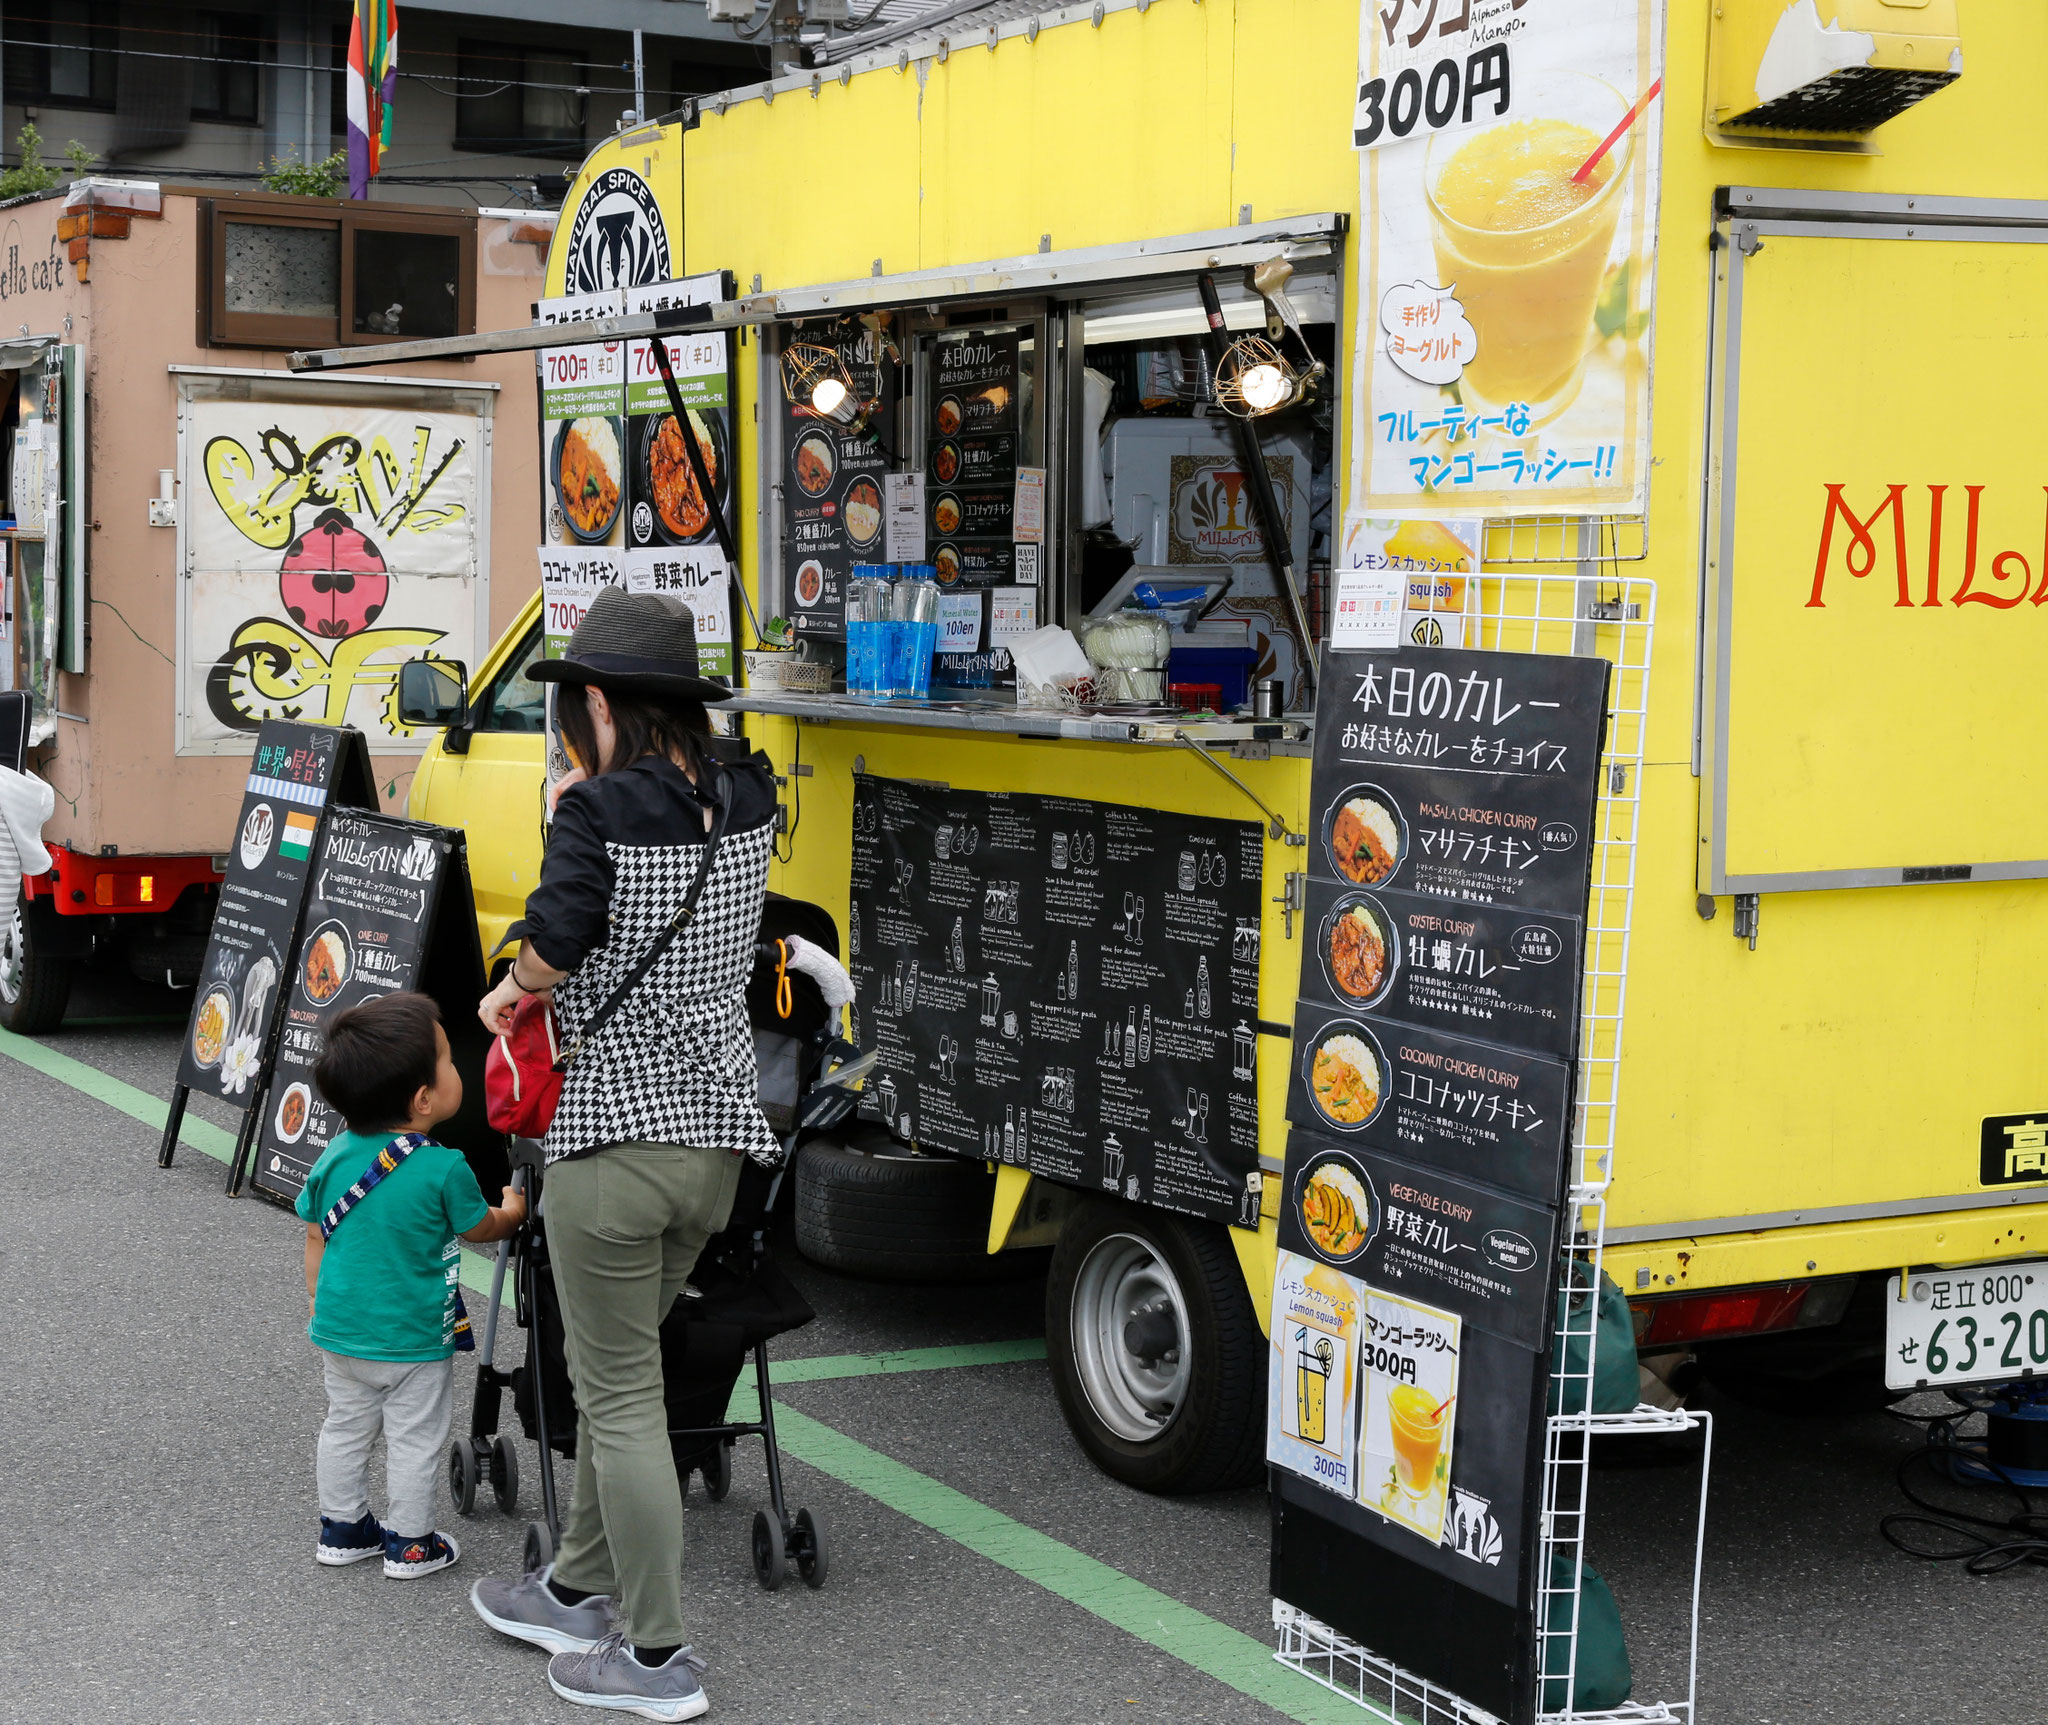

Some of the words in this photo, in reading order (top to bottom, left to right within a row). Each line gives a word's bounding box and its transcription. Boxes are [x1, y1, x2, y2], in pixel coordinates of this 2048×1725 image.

[1470, 2, 1511, 25] Alphonso
[1354, 42, 1510, 146] 300円
[566, 182, 606, 294] NATURAL
[608, 172, 649, 206] SPICE
[648, 207, 670, 280] ONLY
[32, 234, 64, 290] cafe
[1402, 299, 1441, 327] 手作り
[942, 344, 1007, 368] 本日のカレー
[1393, 332, 1462, 362] ヨーグルト
[548, 354, 587, 382] 700円
[940, 364, 1011, 383] お好きなカレーをチョイス
[1378, 401, 1530, 442] フルーティーな
[1409, 446, 1616, 487] マンゴーラッシー!!
[965, 503, 1012, 516] ココナッツチキン
[795, 522, 842, 540] 2種盛カレー
[1197, 531, 1264, 546] MILLAN
[543, 560, 619, 585] ココナッツチキン
[653, 562, 722, 590] 野菜カレー
[824, 567, 842, 580] カレー
[964, 556, 993, 568] 野菜カレー
[1353, 553, 1452, 573] レモンスカッシュ
[547, 587, 564, 596] Coconut
[564, 589, 579, 597] Chicken
[580, 590, 592, 598] Curry
[683, 591, 697, 602] Curry
[1409, 582, 1452, 599] squash
[941, 654, 988, 672] MILLAN
[1352, 664, 1560, 725] 本日のカレー
[1341, 723, 1568, 773] お好きなカレーをチョイス
[257, 745, 326, 783] 世界の屋台から
[331, 816, 380, 838] 南インドカレー
[1420, 802, 1457, 821] MASALA
[1459, 807, 1502, 826] CHICKEN
[1504, 812, 1537, 831] CURRY
[324, 835, 401, 873] MILLAN
[1419, 828, 1540, 870] マサラチキン
[357, 930, 373, 942] ONE
[1409, 915, 1442, 931] OYSTER
[1444, 919, 1475, 937] CURRY
[1524, 931, 1548, 943] 広島産
[1408, 934, 1521, 979] 牡蠣カレー
[1520, 944, 1552, 956] 大粒牡蠣
[1400, 1046, 1443, 1070] COCONUT
[1444, 1057, 1485, 1081] CHICKEN
[1487, 1068, 1519, 1089] CURRY
[311, 1100, 336, 1116] カレー
[1228, 1092, 1247, 1104] Coffee
[1399, 1070, 1543, 1132] ココナッツチキン
[308, 1117, 327, 1135] 単品
[307, 1135, 328, 1148] 500yen
[1179, 1146, 1197, 1156] dinner
[2003, 1120, 2048, 1178] 高
[1389, 1182, 1440, 1212] VEGETABLE
[1441, 1200, 1473, 1222] CURRY
[1387, 1205, 1477, 1254] 野菜カレー
[1490, 1235, 1530, 1256] Vegetarians
[1500, 1252, 1518, 1264] menu
[1281, 1277, 1348, 1312] レモンスカッシュ
[1930, 1279, 1976, 1310] 足立
[1982, 1274, 2022, 1305] 800
[1289, 1299, 1314, 1319] Lemon
[1314, 1307, 1344, 1328] squash
[1365, 1313, 1458, 1356] マンゴーラッシー
[1898, 1337, 1919, 1364] せ
[1926, 1309, 2048, 1375] 63-20
[1363, 1344, 1417, 1385] 300円
[1313, 1455, 1348, 1486] 300円
